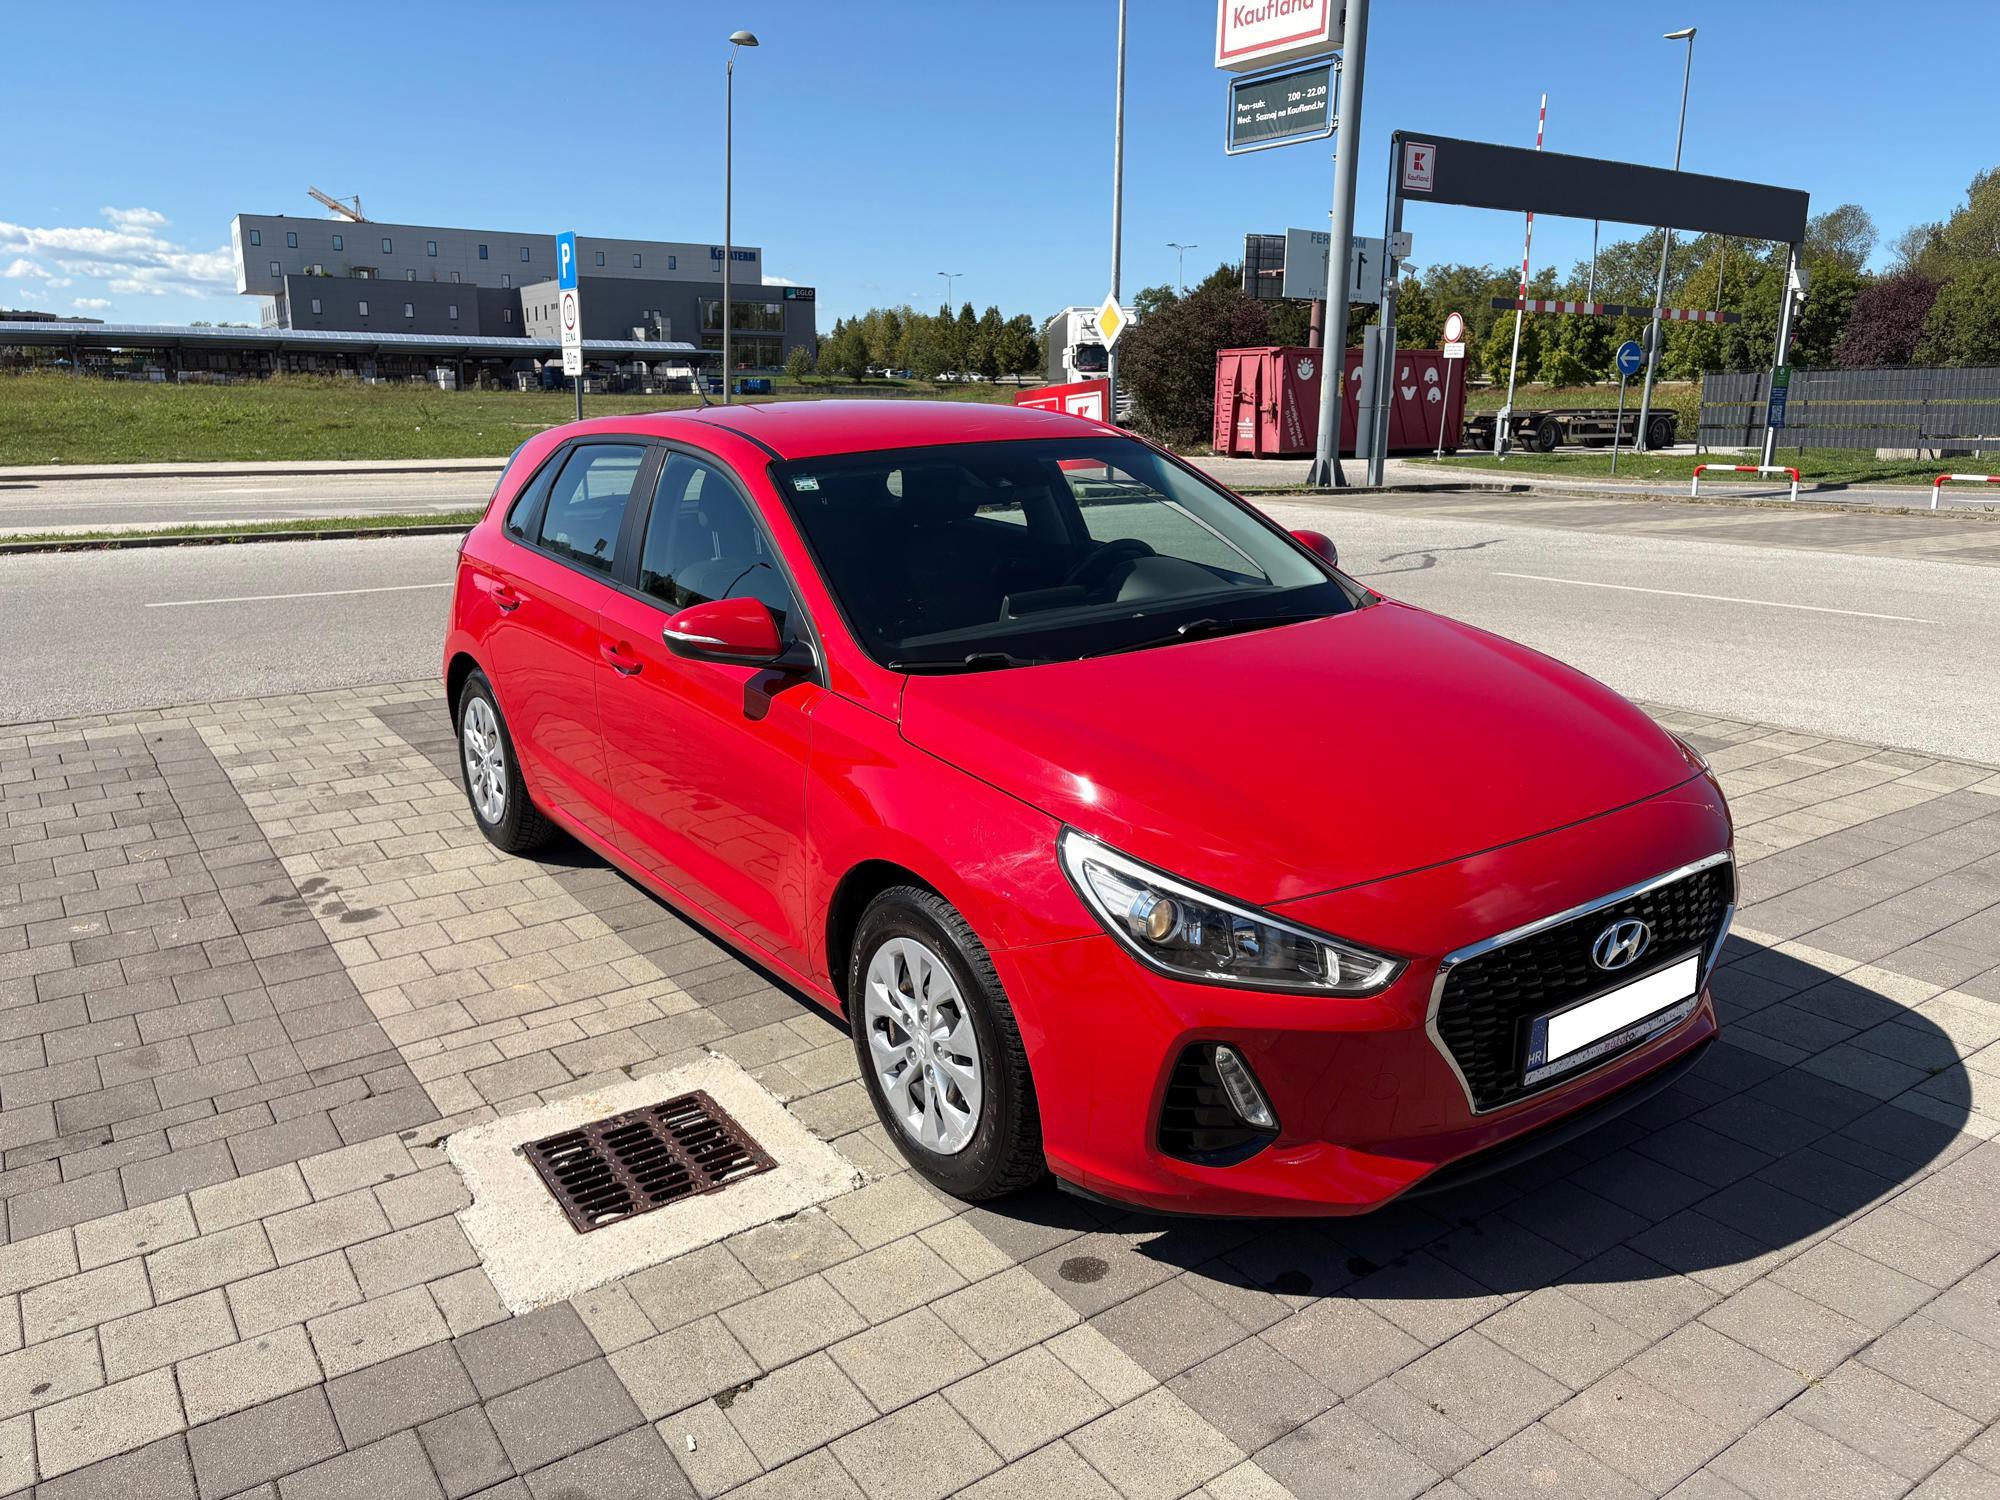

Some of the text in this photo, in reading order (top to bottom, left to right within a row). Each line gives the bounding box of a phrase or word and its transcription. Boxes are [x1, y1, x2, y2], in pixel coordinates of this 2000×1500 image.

[1237, 100, 1266, 112] Pon-sub:
[1307, 85, 1327, 98] 22.00
[1236, 101, 1326, 125] Ned: Saznaj na Kaufland.hr
[1407, 174, 1430, 182] Kaufland
[561, 242, 570, 279] P
[796, 289, 814, 297] EGLO
[1527, 1050, 1542, 1066] HR
